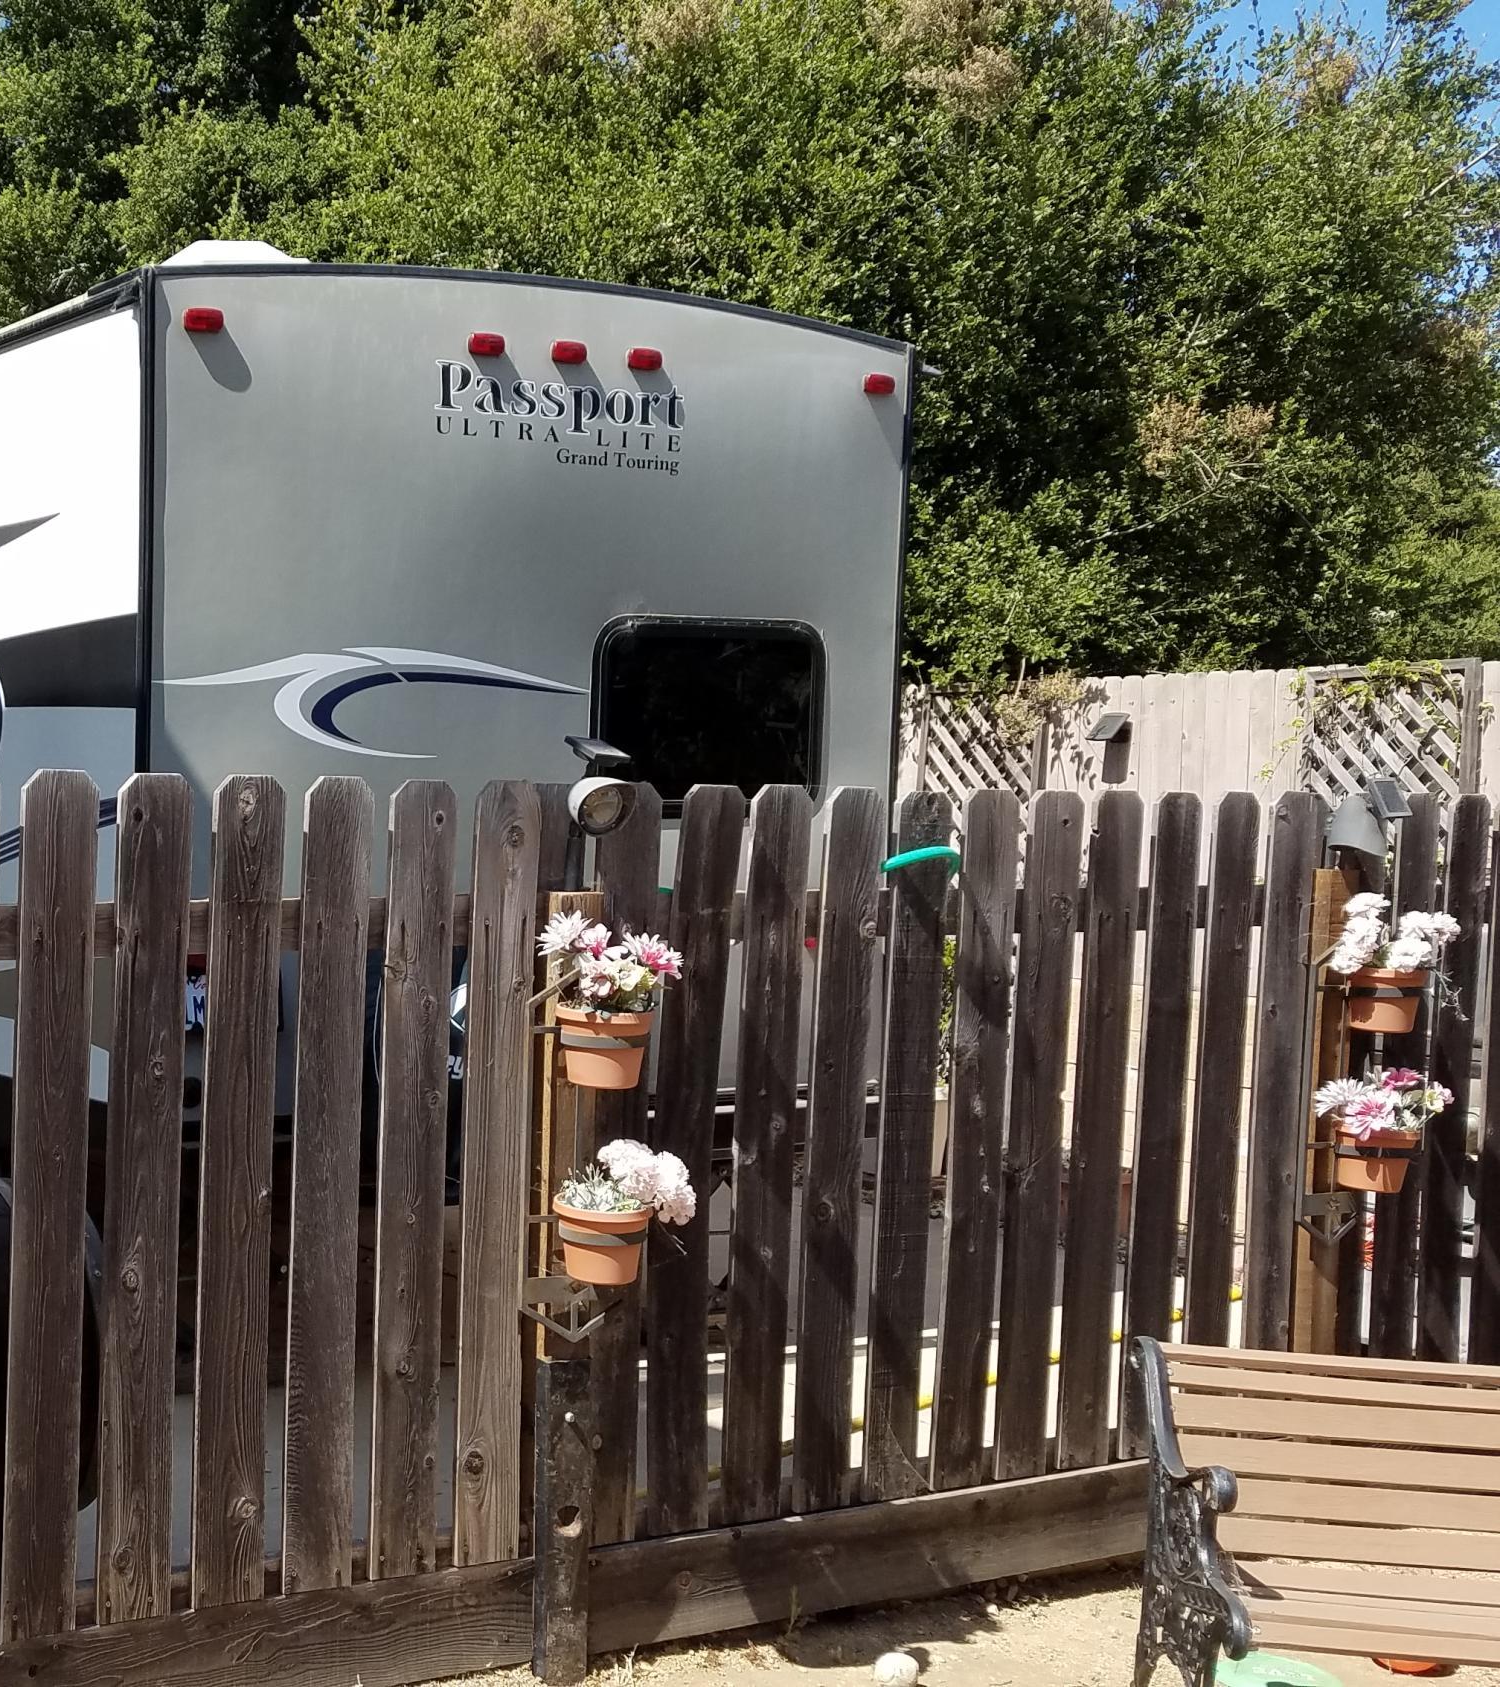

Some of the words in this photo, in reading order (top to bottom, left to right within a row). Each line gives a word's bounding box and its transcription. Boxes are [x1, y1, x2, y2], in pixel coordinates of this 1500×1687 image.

[434, 359, 685, 435] Passport
[436, 415, 560, 443] ULTRA
[596, 428, 681, 453] LITE
[556, 448, 608, 467] Grand
[614, 452, 680, 476] Touring
